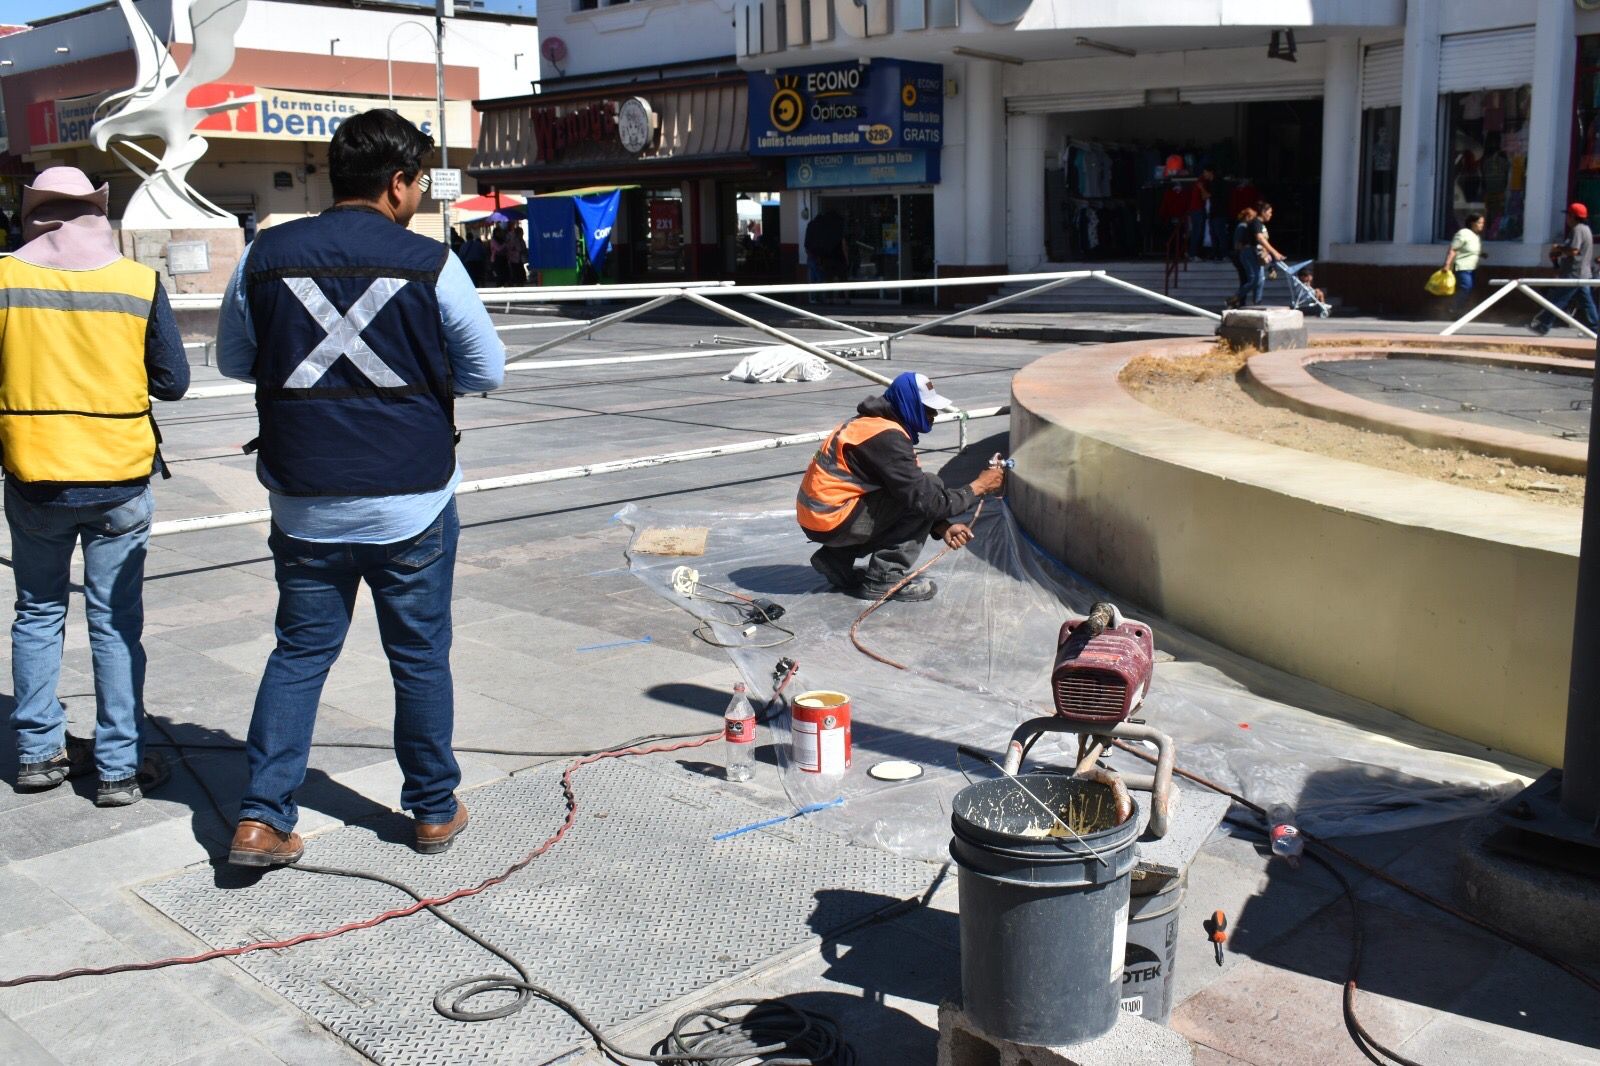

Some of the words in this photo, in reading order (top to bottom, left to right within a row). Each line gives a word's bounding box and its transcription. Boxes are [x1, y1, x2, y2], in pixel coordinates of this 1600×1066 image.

[807, 70, 859, 92] ECONO
[272, 97, 355, 113] farmacias
[810, 101, 858, 122] Ópticas
[758, 136, 785, 148] Lentes
[785, 133, 831, 147] Completos
[832, 132, 860, 144] Desde
[903, 127, 940, 142] GRATIS
